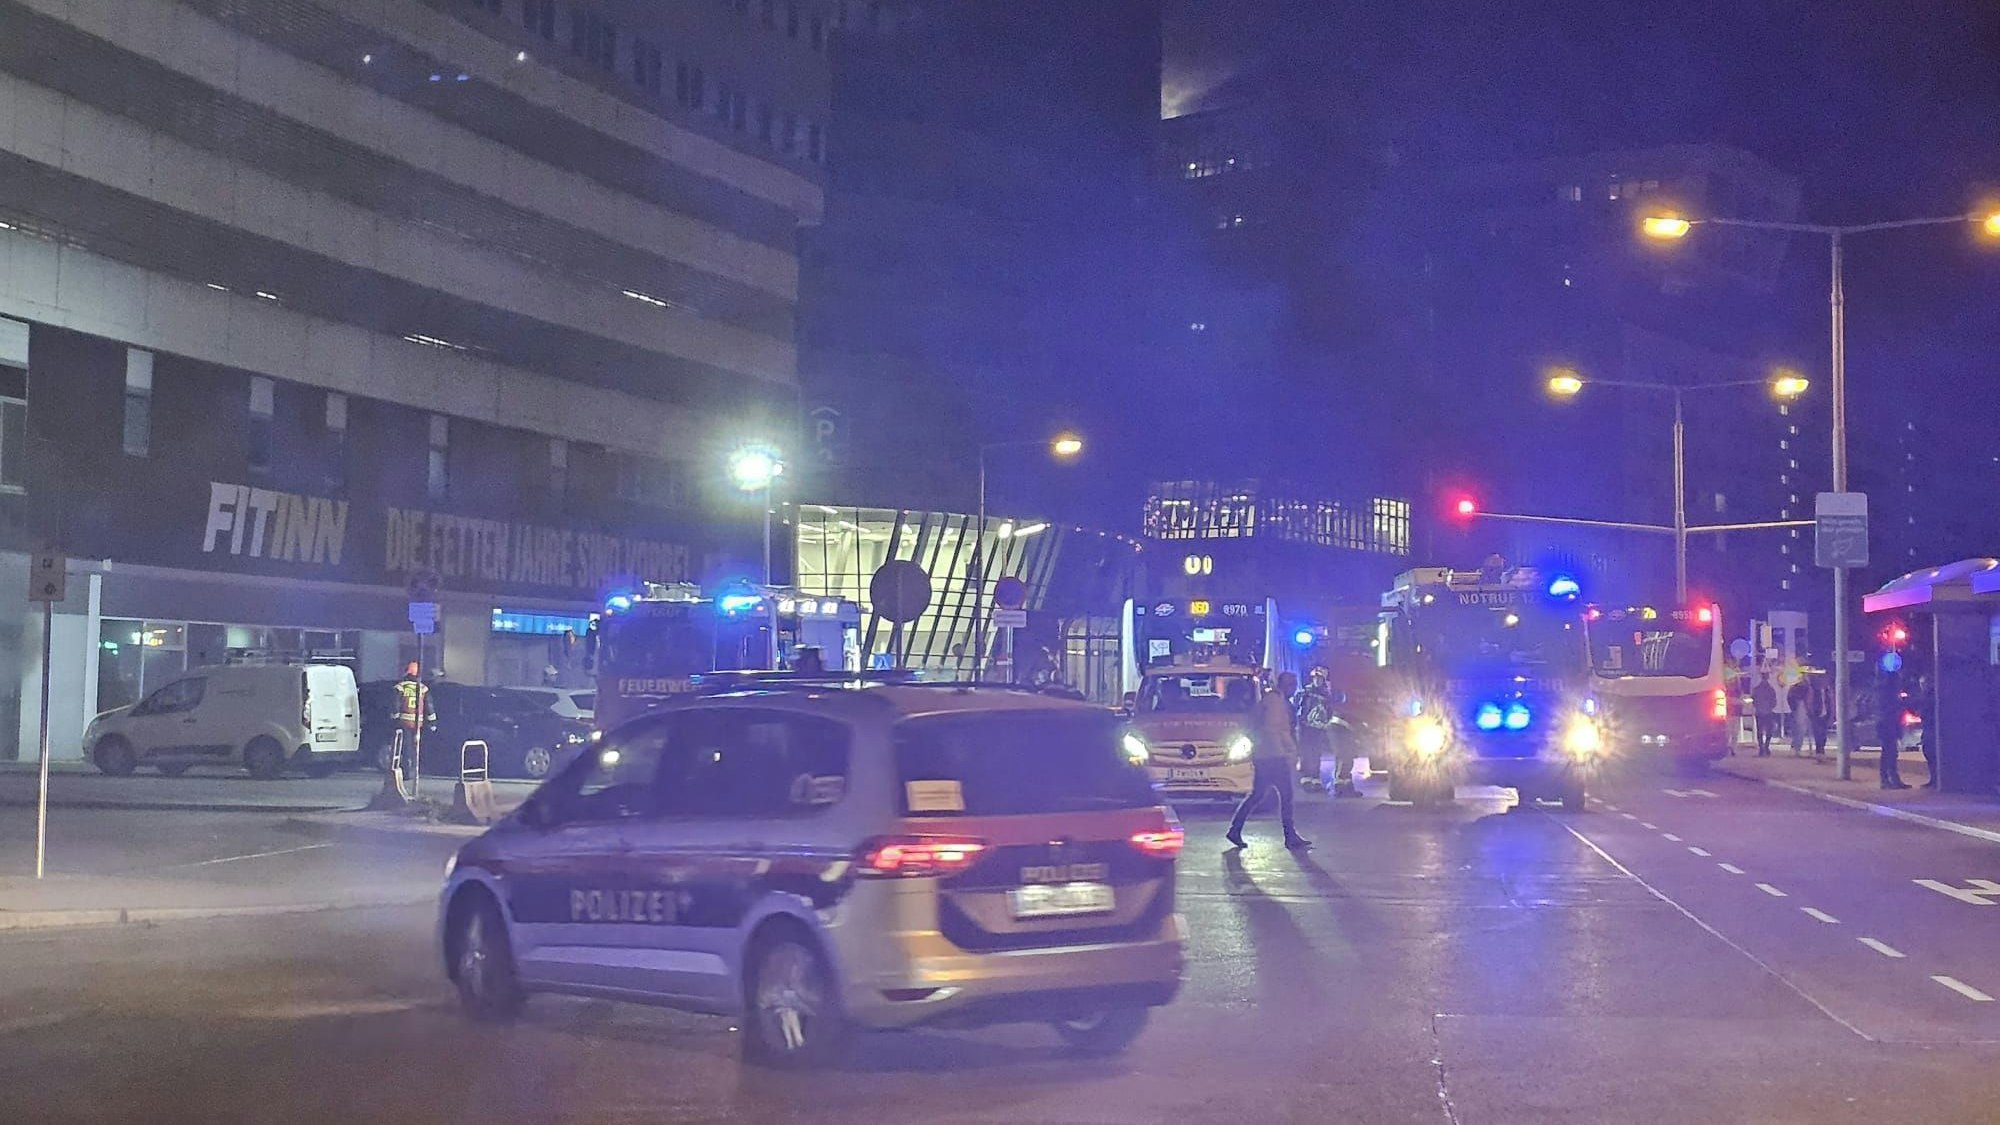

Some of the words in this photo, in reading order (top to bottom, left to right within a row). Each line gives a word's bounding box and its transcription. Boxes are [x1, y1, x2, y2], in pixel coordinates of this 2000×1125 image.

[384, 507, 425, 571] DIE
[429, 513, 509, 582] FETTEN
[511, 523, 573, 588] JAHRE
[1460, 592, 1517, 604] NOTRUF
[619, 679, 700, 693] FEUERWE
[569, 889, 676, 922] POLIZEI
